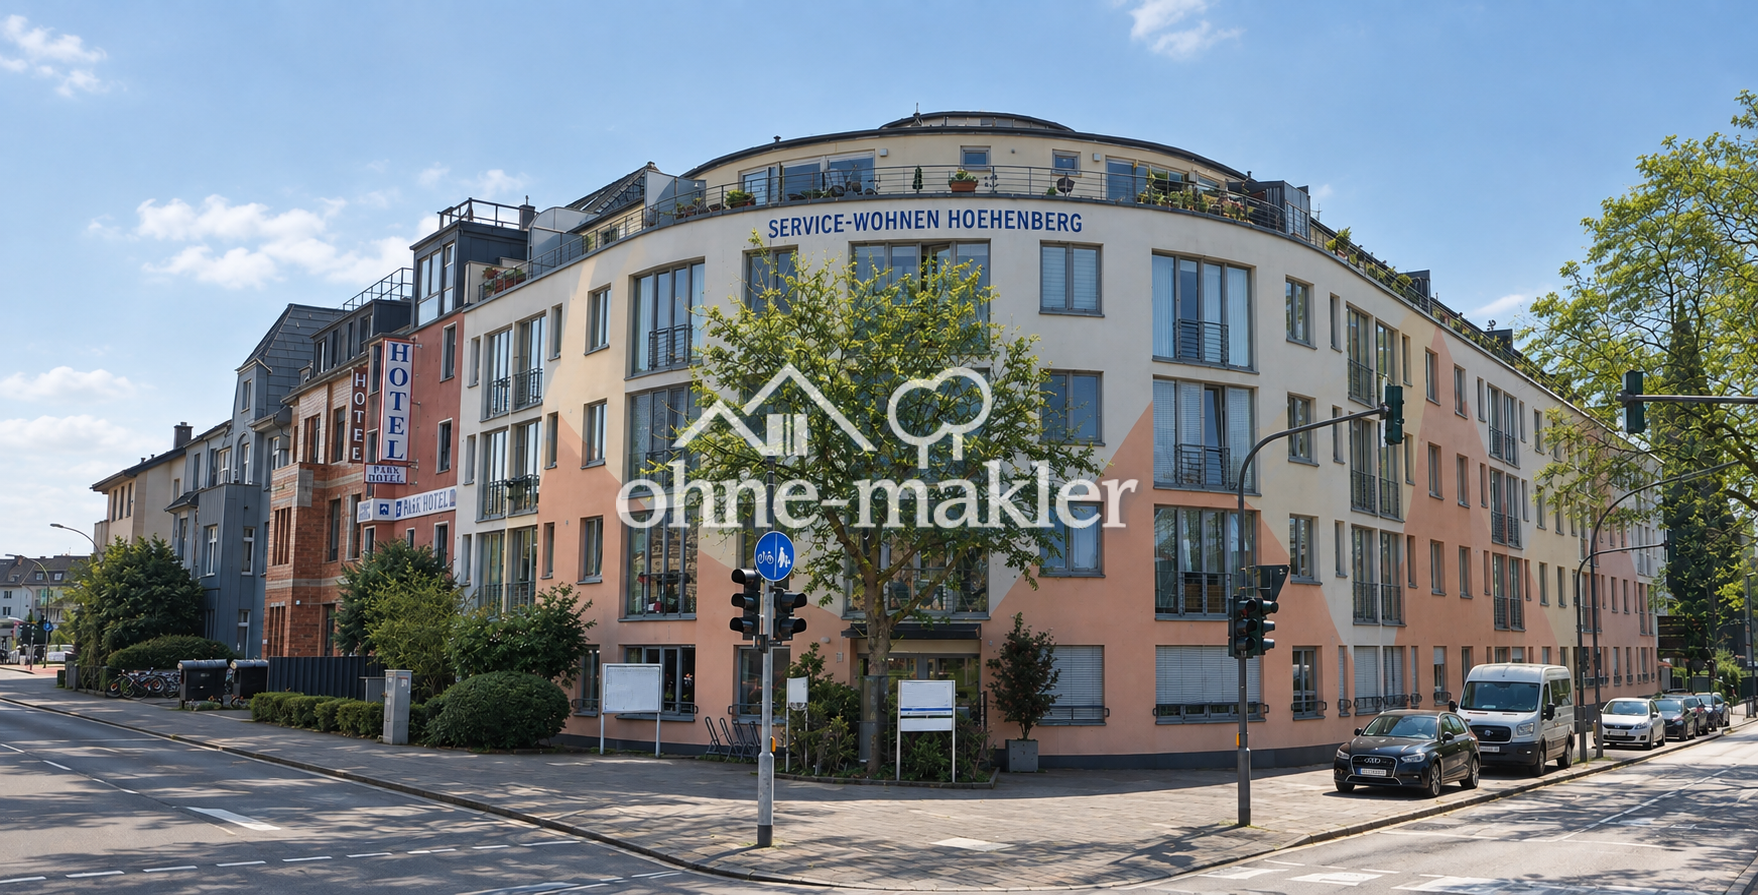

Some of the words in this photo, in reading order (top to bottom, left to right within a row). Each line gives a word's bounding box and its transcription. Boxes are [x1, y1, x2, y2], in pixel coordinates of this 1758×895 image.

[768, 209, 940, 239] SERVICE-WOHNEN
[948, 208, 1083, 233] HOEHENBERG
[387, 343, 409, 459] HOTEL
[423, 491, 448, 511] HOTEL
